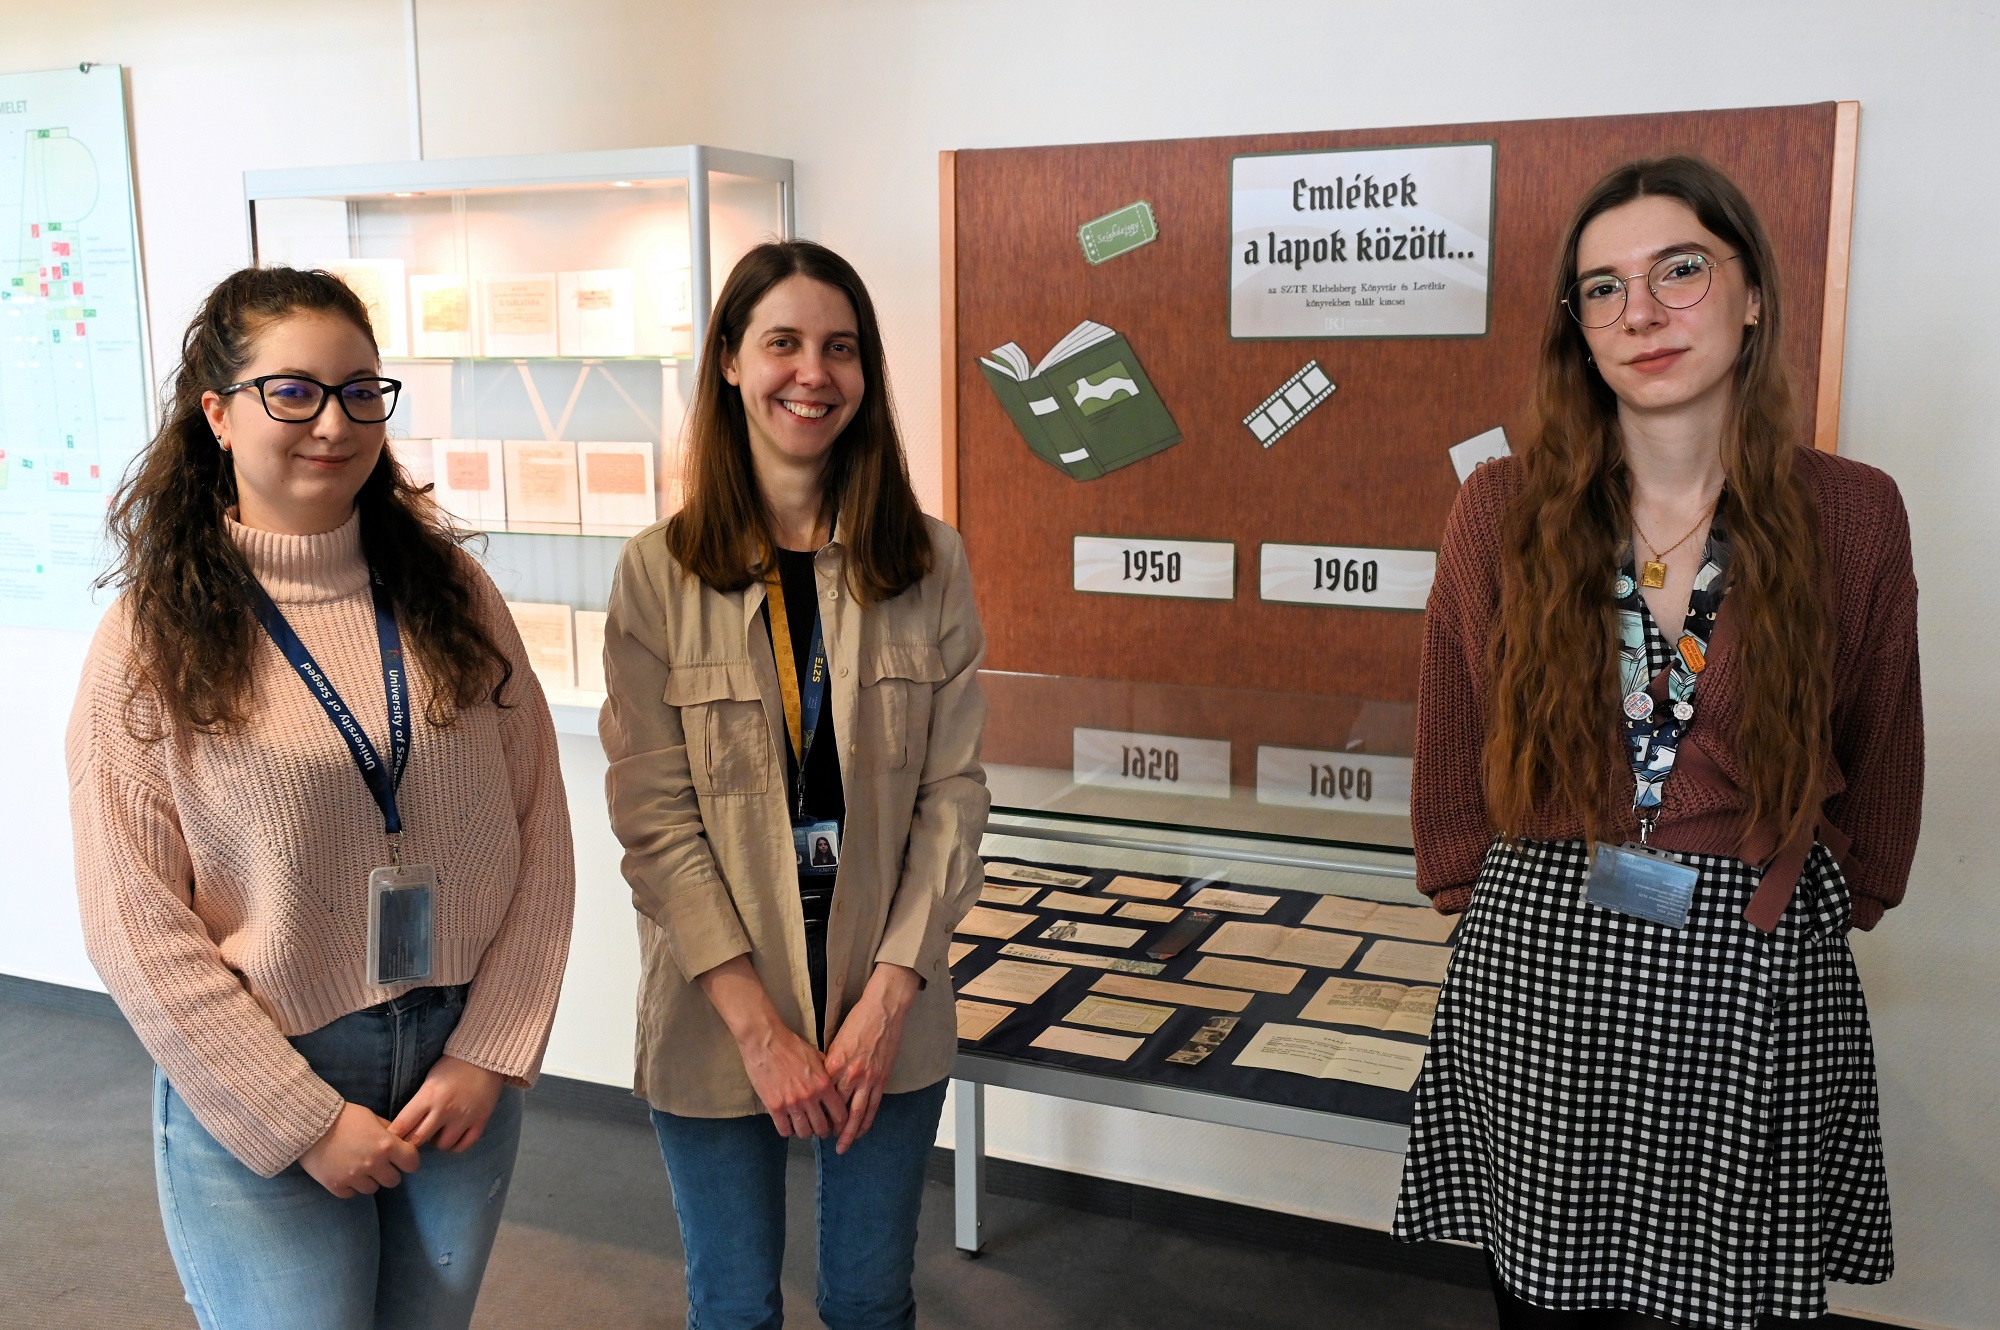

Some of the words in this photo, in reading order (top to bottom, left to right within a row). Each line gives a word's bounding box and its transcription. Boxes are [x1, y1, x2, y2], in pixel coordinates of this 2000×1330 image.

[1292, 173, 1418, 212] Emlékek
[1244, 240, 1260, 265] a
[1268, 229, 1347, 271] lapok
[1356, 225, 1475, 262] között...
[1280, 284, 1308, 294] SZTE
[1312, 283, 1357, 295] Klebelsberg
[1360, 283, 1397, 294] Könyvtár
[1401, 283, 1409, 291] és
[1413, 281, 1446, 291] Levéltár
[1305, 298, 1351, 309] könyvekben
[1354, 297, 1375, 306] talált
[1379, 297, 1406, 306] kincsei
[1122, 549, 1181, 583] 1950
[1313, 557, 1378, 593] 1960
[300, 661, 332, 700] Szeged
[812, 656, 824, 683] SZTE
[327, 699, 342, 713] of
[388, 669, 403, 728] University
[1638, 700, 1651, 714] LOVE
[339, 713, 375, 771] University
[395, 729, 406, 742] of
